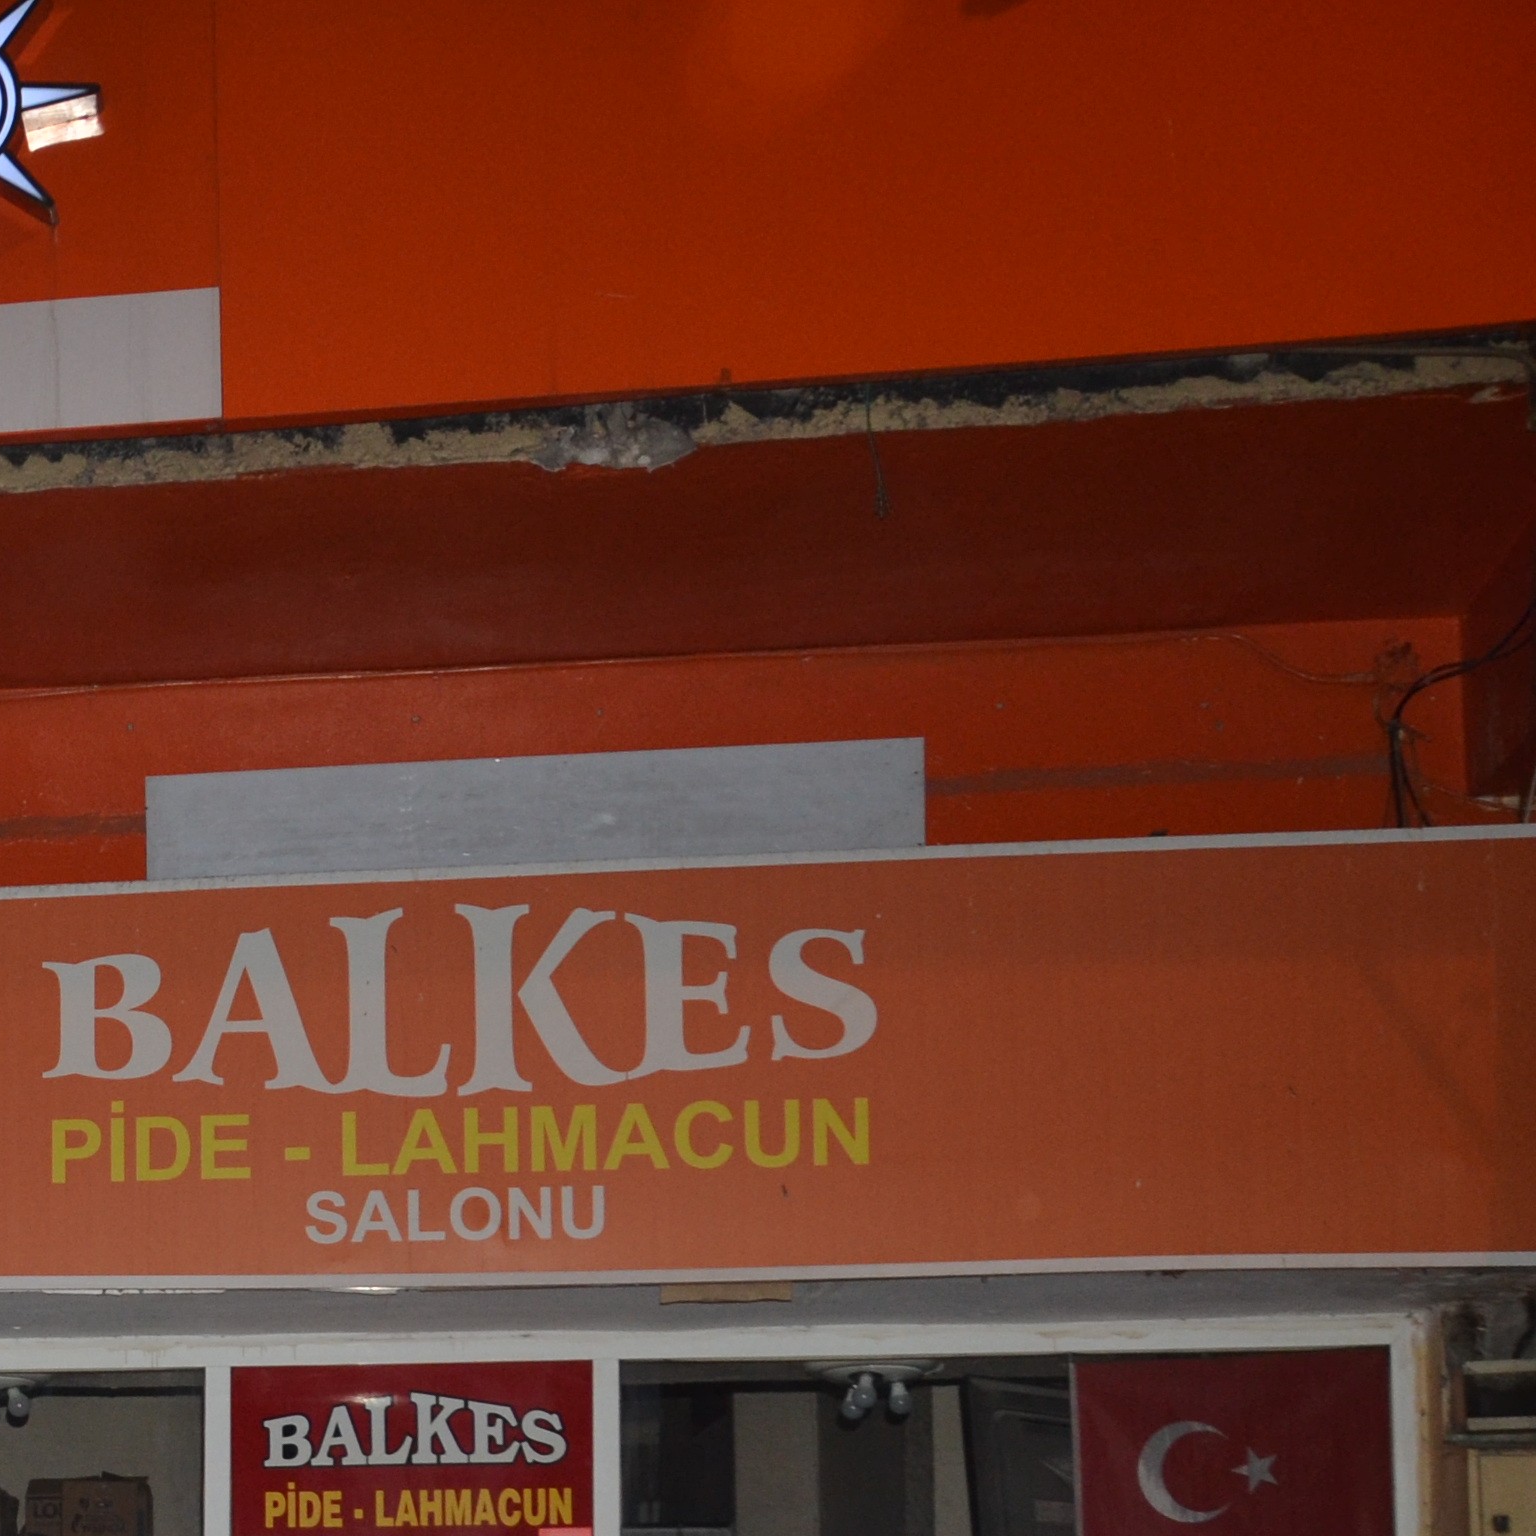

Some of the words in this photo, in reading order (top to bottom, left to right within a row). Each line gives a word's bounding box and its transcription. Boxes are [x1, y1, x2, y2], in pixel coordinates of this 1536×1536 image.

[41, 903, 879, 1098] BALKES
[50, 1099, 252, 1184] PİDE
[341, 1096, 872, 1177] LAHMACUN
[303, 1185, 608, 1246] SALONU
[263, 1391, 568, 1468] BALKES
[264, 1482, 343, 1528] PİDE
[375, 1487, 573, 1528] LAHMACUN
